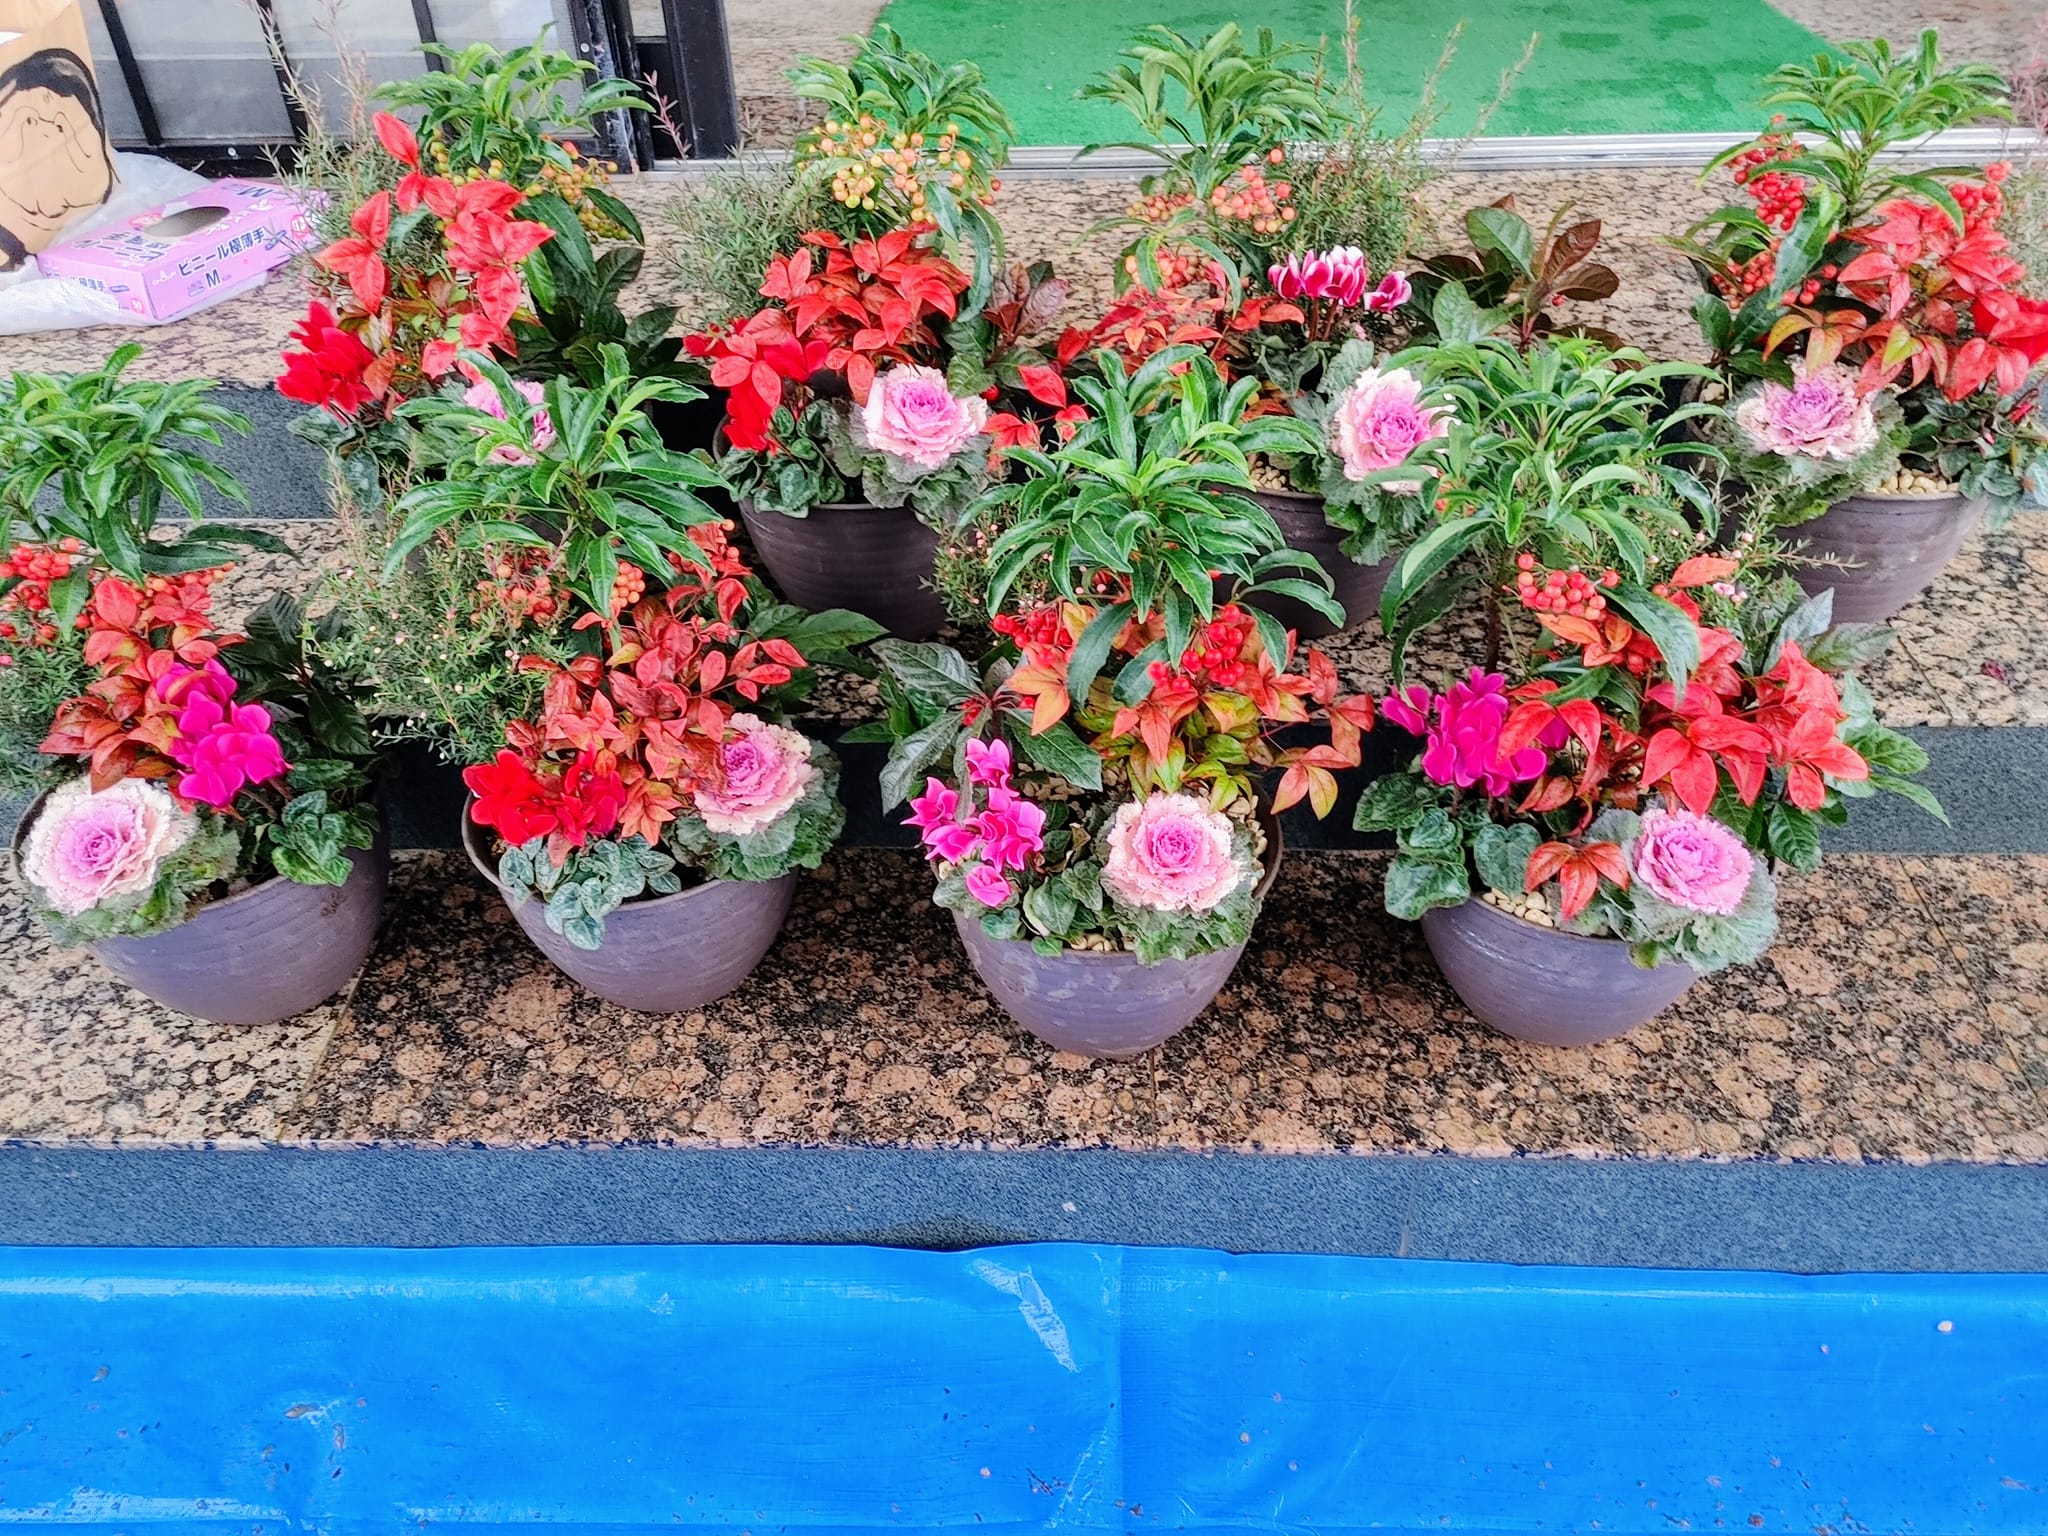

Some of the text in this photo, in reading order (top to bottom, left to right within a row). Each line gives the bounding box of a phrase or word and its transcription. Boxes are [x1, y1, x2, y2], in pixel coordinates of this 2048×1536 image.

[178, 226, 265, 277] ビニール極薄手
[205, 269, 221, 288] M
